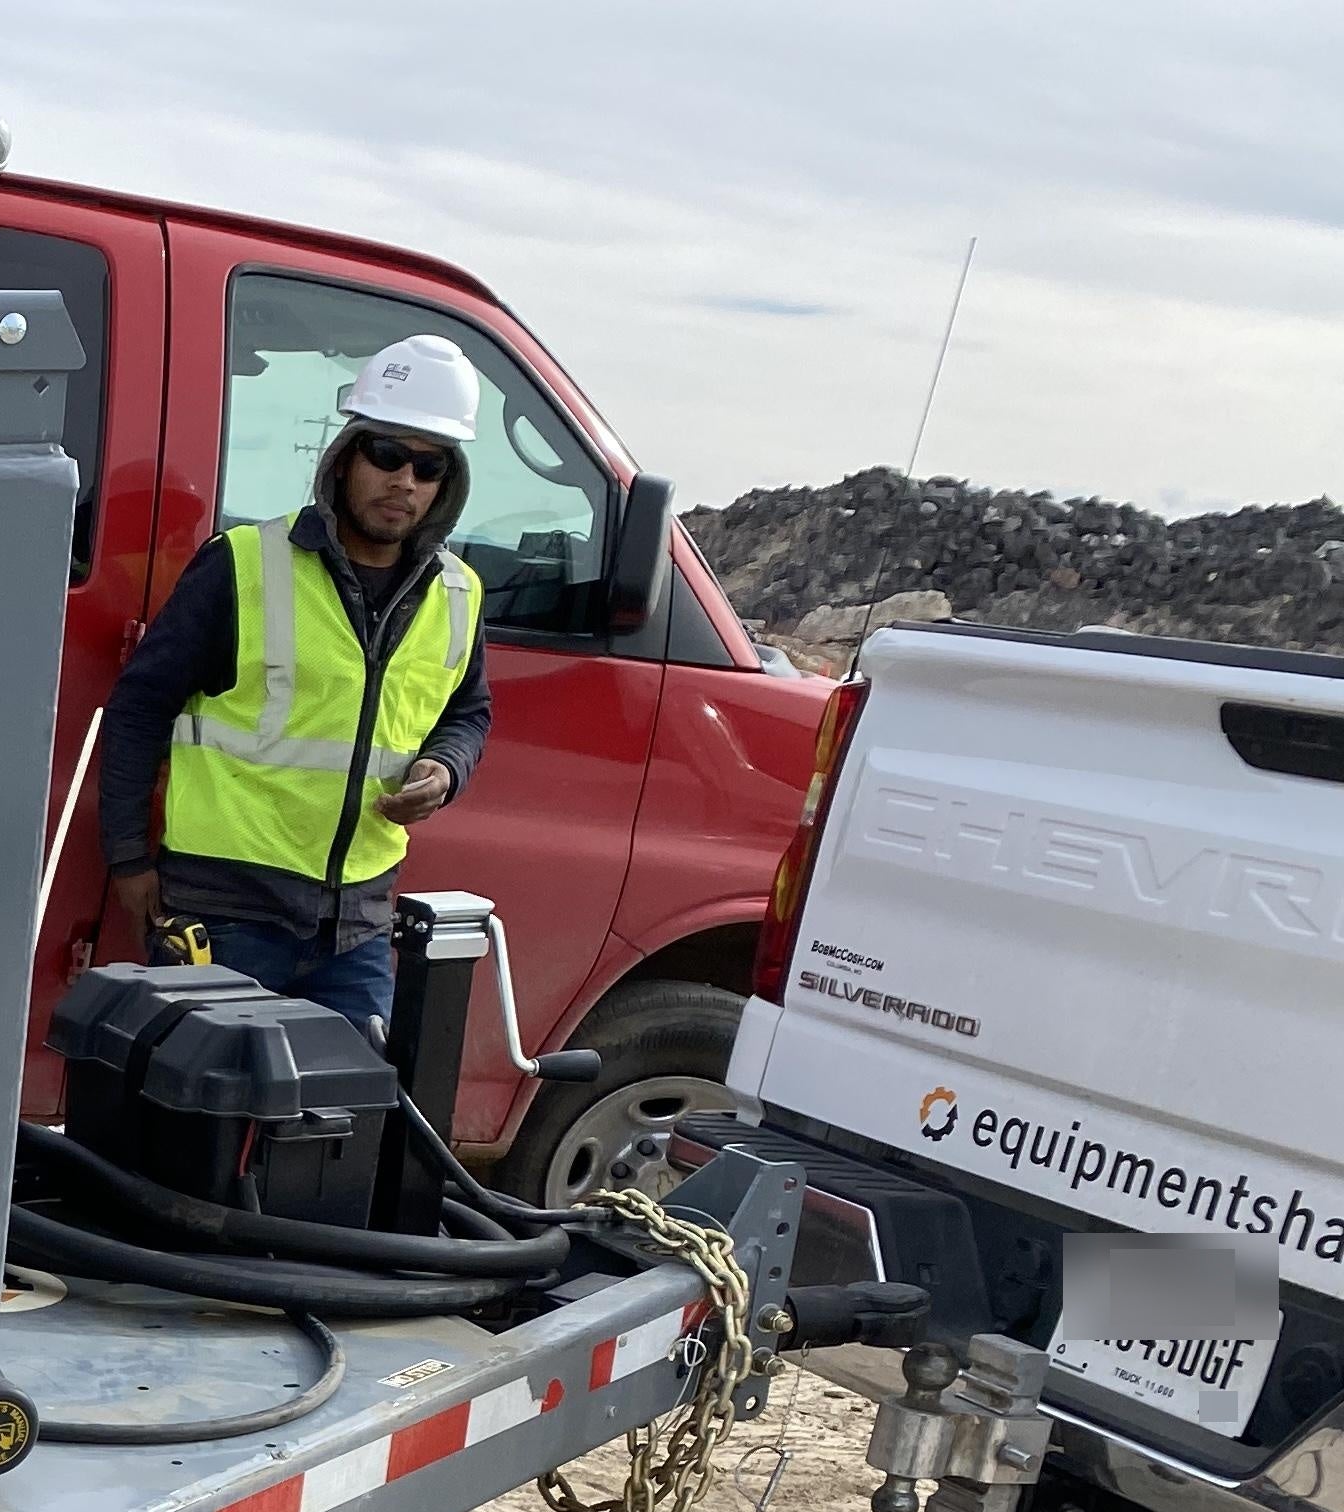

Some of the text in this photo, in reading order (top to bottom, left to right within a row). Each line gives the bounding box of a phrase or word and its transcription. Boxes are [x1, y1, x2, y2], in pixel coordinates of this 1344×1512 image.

[863, 786, 1344, 946] CHEVR
[799, 971, 981, 1037] SILVERADO
[1114, 1367, 1175, 1398] TRUCK 11,000
